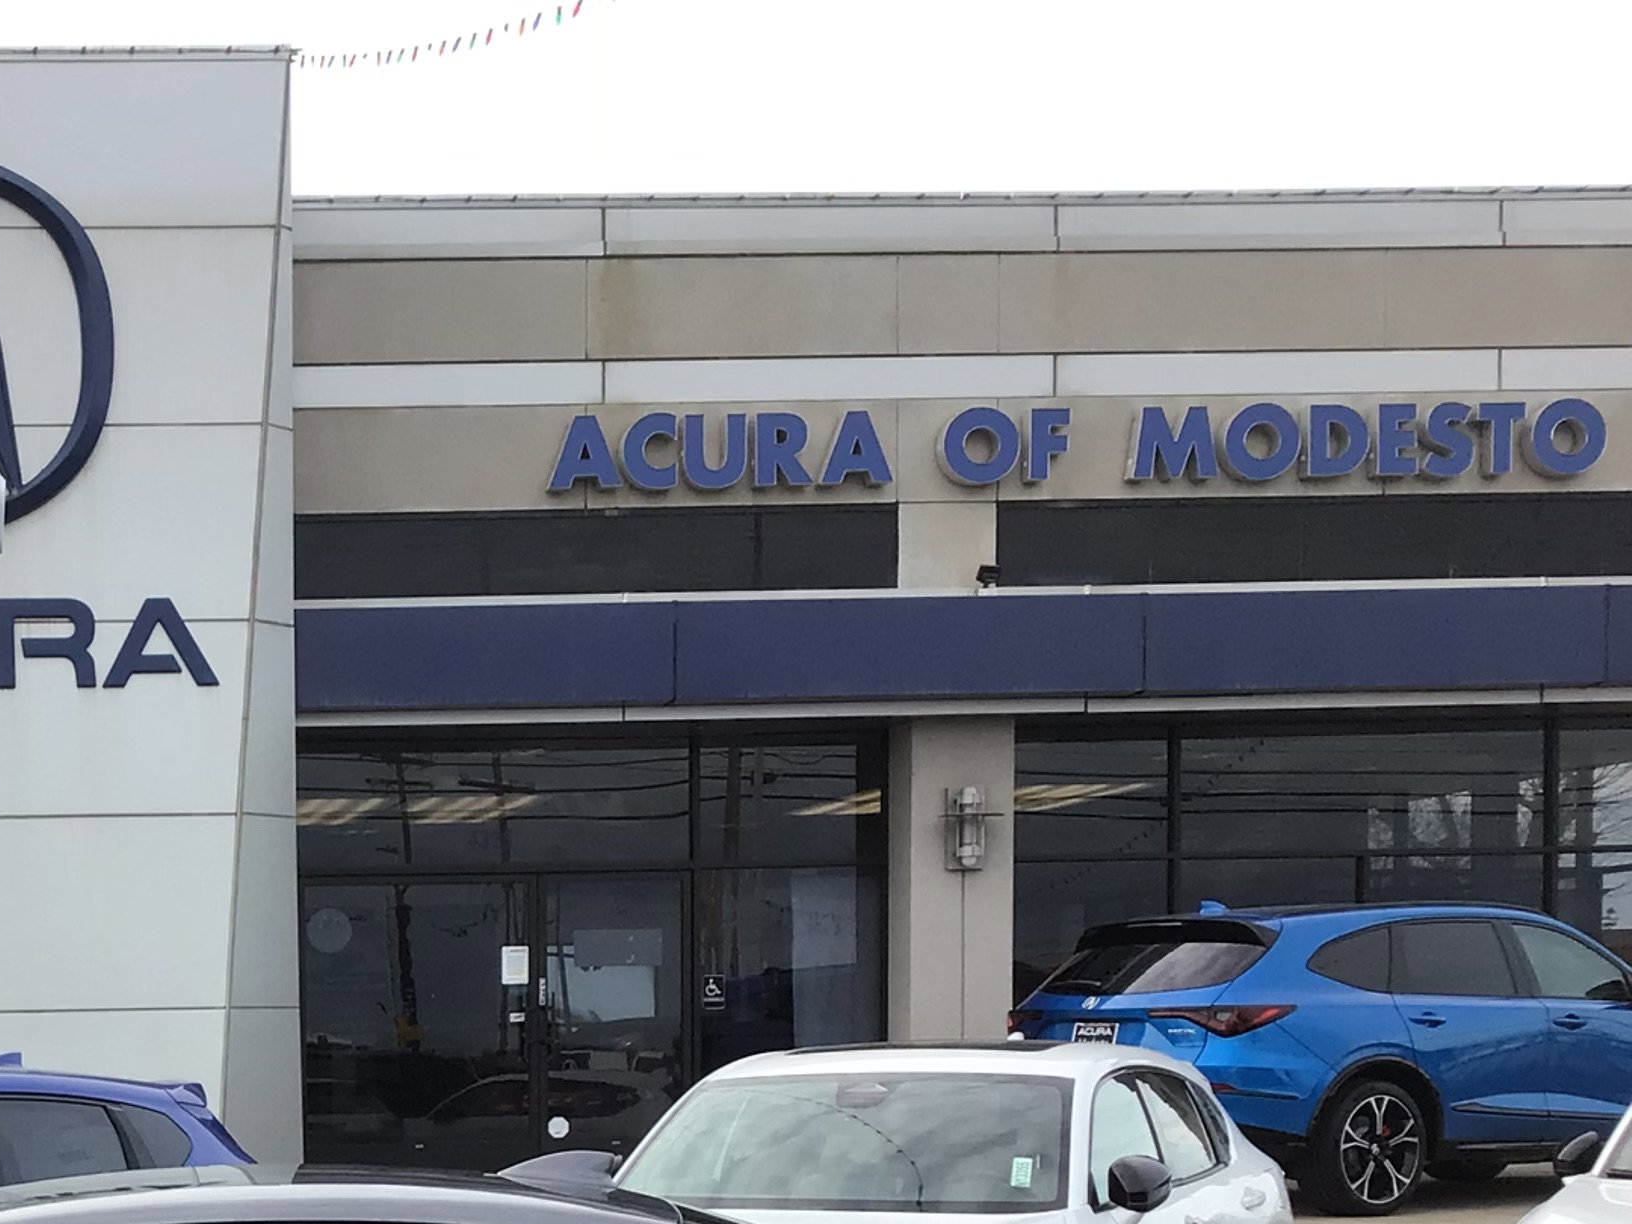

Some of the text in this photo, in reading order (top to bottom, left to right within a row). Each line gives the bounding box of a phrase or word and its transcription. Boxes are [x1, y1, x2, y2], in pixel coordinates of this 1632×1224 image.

[546, 396, 1608, 491] ACURA OF MODESTO
[1077, 1026, 1113, 1037] ACURA
